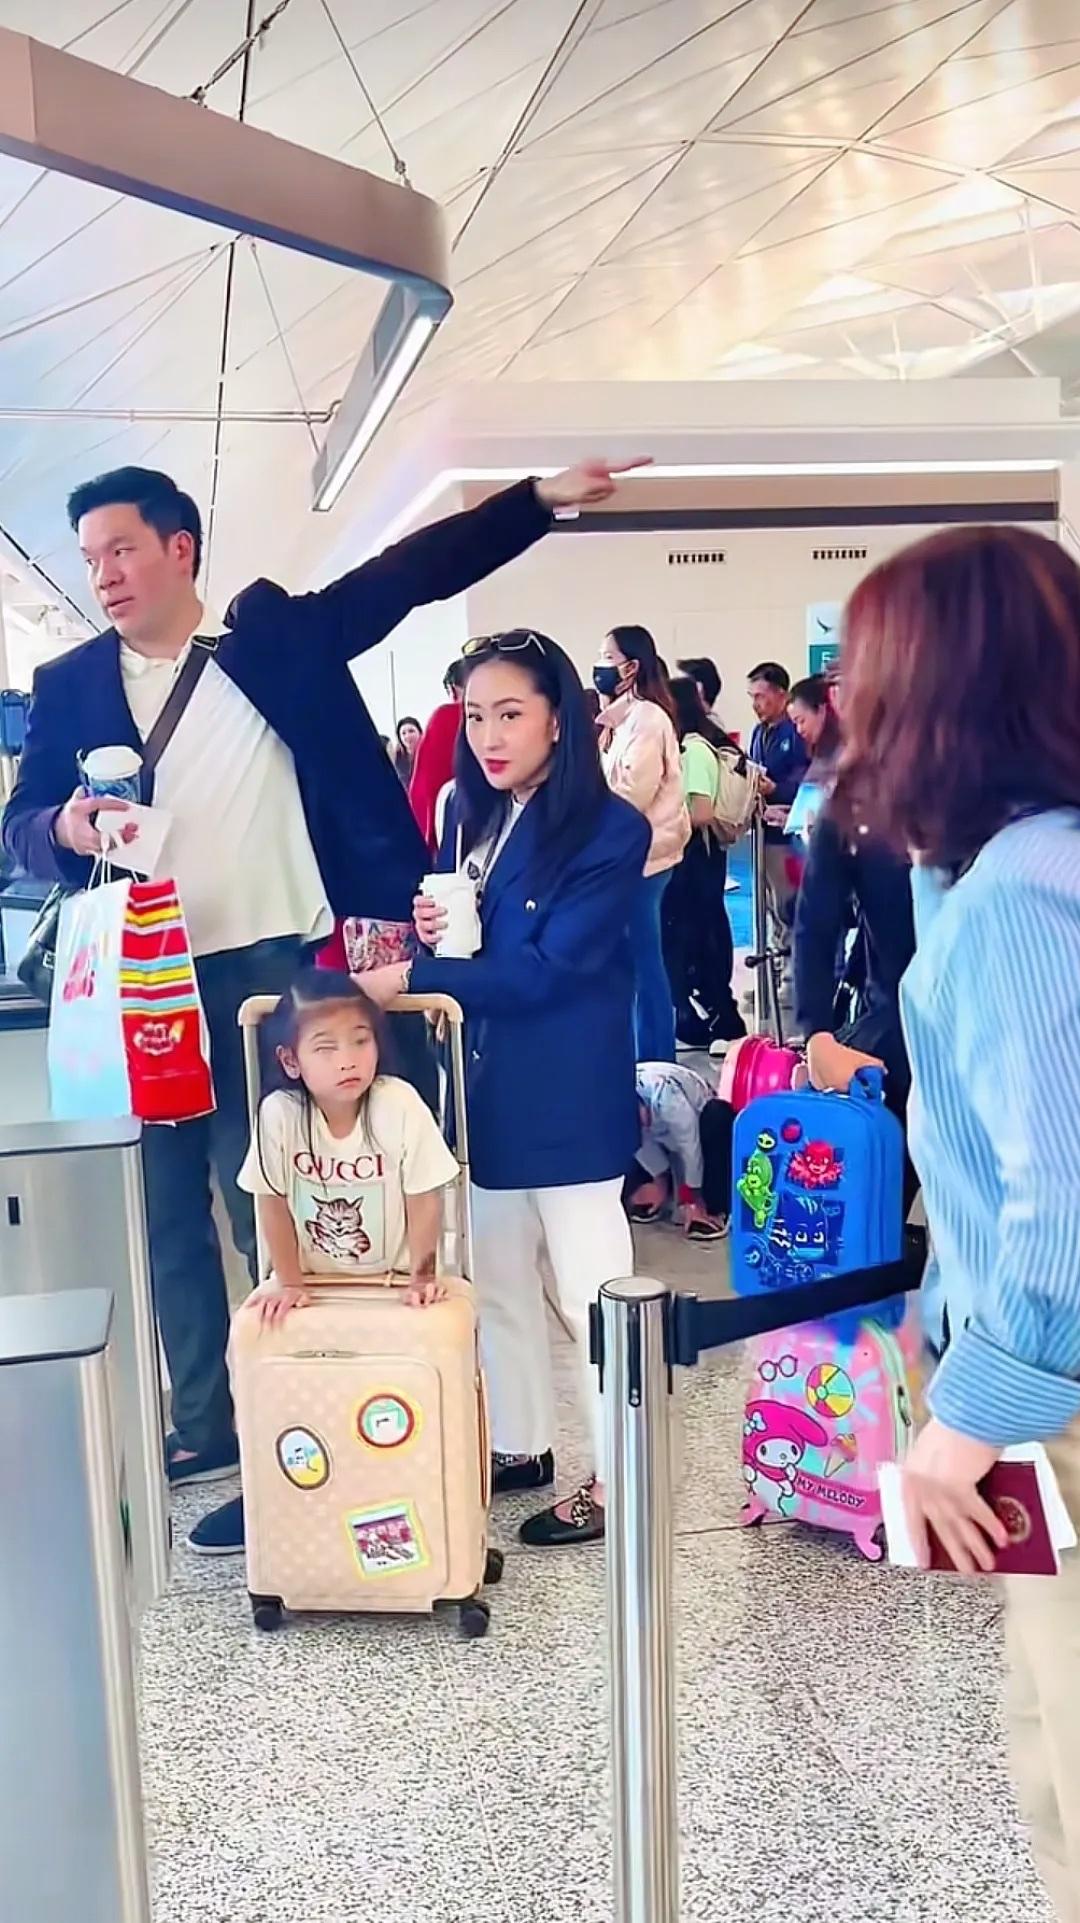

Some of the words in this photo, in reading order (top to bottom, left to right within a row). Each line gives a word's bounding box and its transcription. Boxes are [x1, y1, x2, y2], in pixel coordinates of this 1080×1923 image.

[294, 1152, 383, 1182] GUCCI
[797, 1476, 814, 1491] MY
[817, 1485, 865, 1508] MELODY
